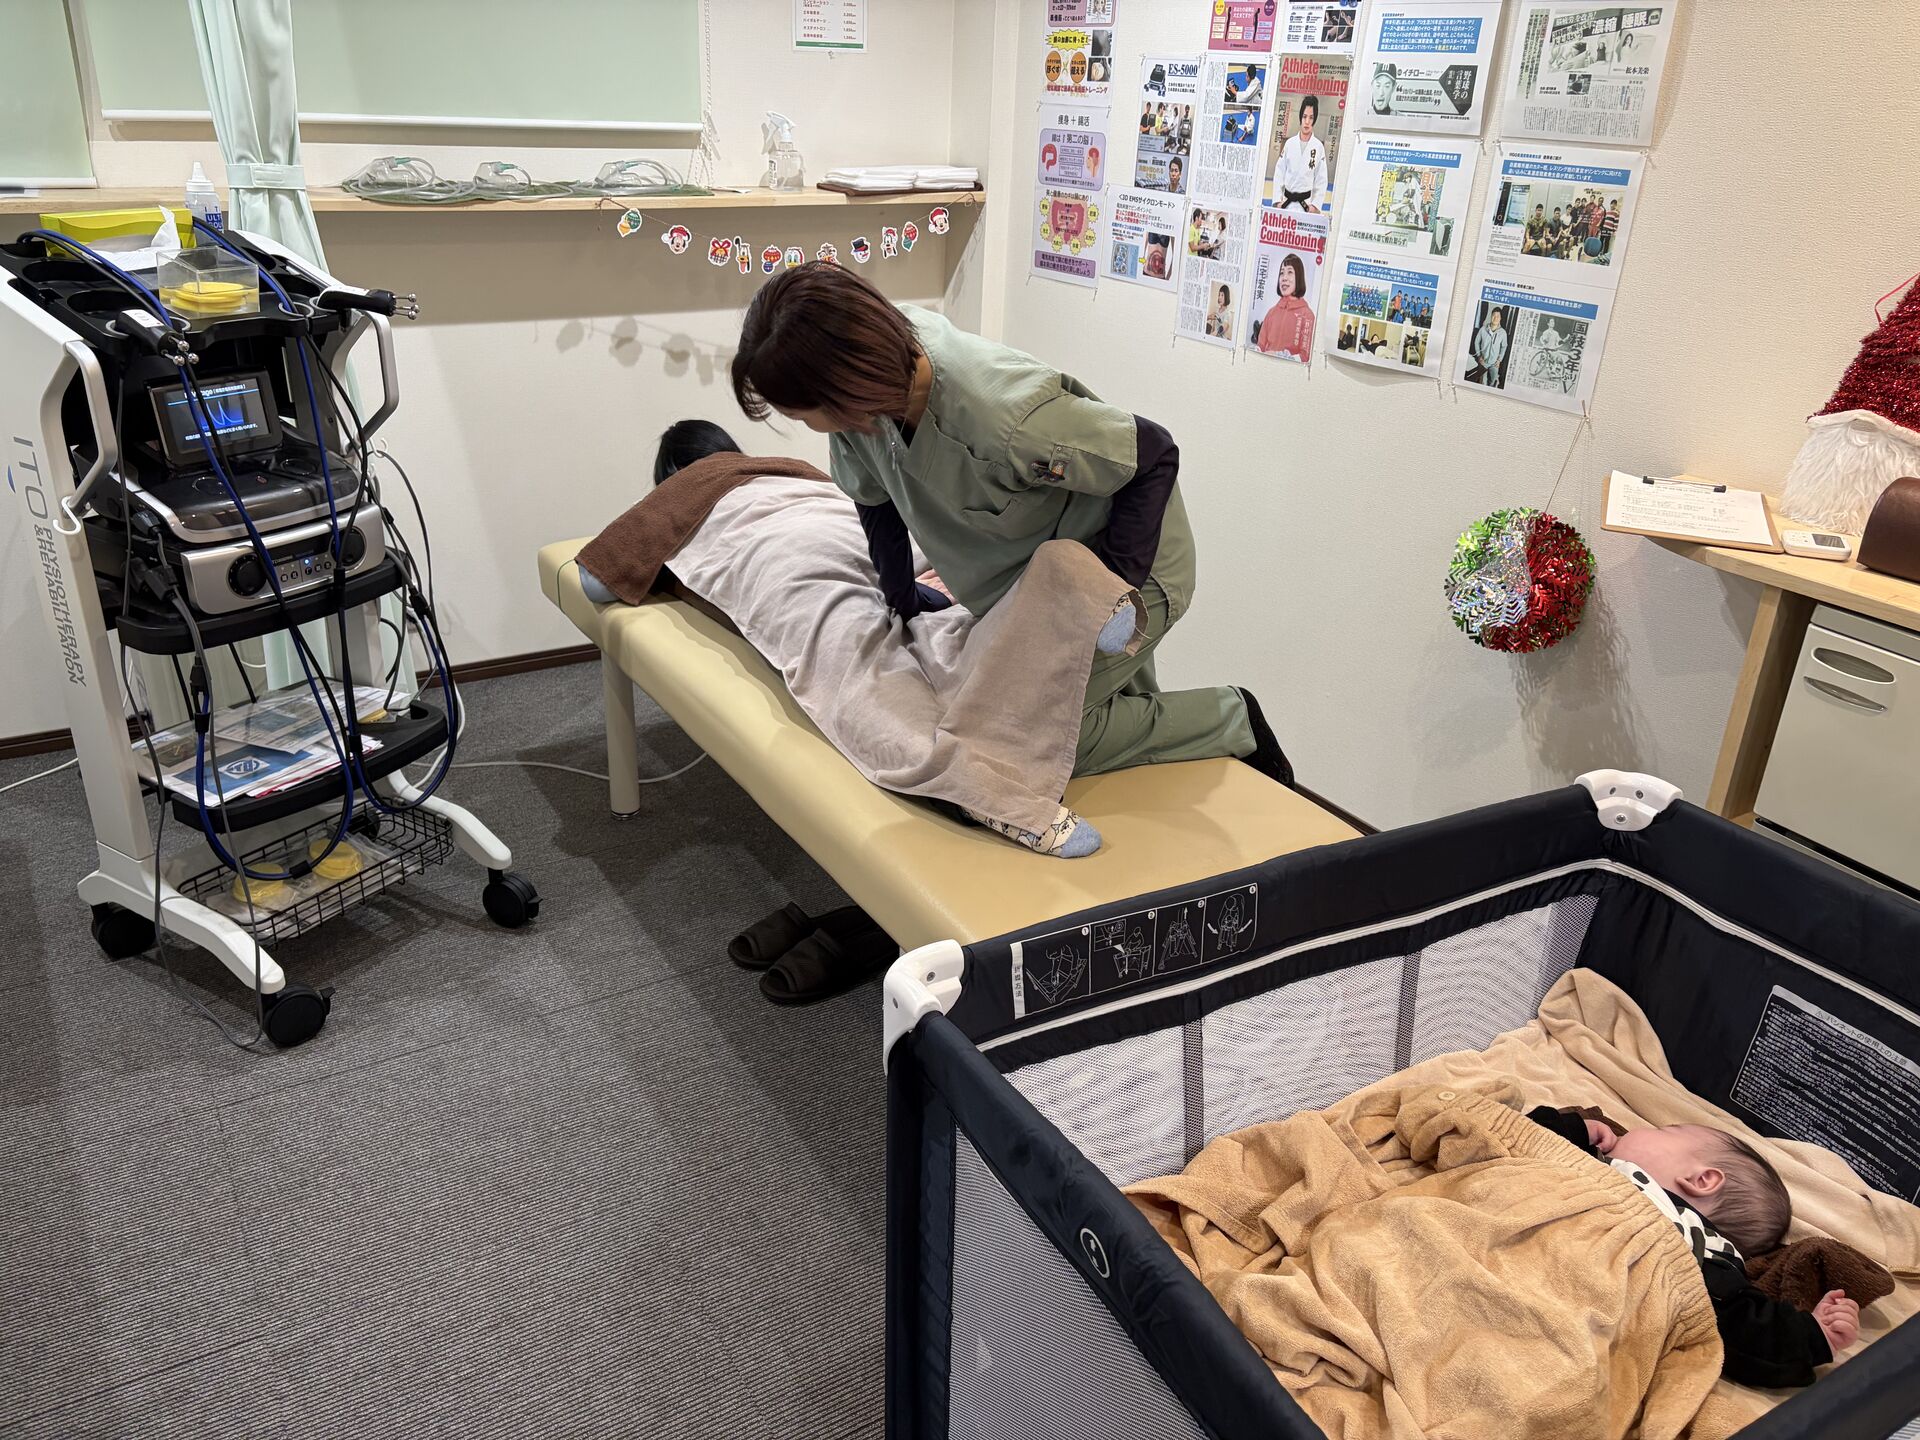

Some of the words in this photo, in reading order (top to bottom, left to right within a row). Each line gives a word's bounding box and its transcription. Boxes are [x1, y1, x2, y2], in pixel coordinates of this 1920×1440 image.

[1047, 65, 1060, 74] ほぐす
[1168, 63, 1199, 76] ES-5000
[1282, 57, 1319, 75] Athlete
[1403, 69, 1425, 77] イチロー
[1280, 73, 1349, 97] Conditioning
[1261, 211, 1297, 231] Athlete
[1260, 226, 1326, 254] Conditioning
[13, 436, 48, 519] ITO
[43, 527, 87, 687] PHYSIOTHERAPY
